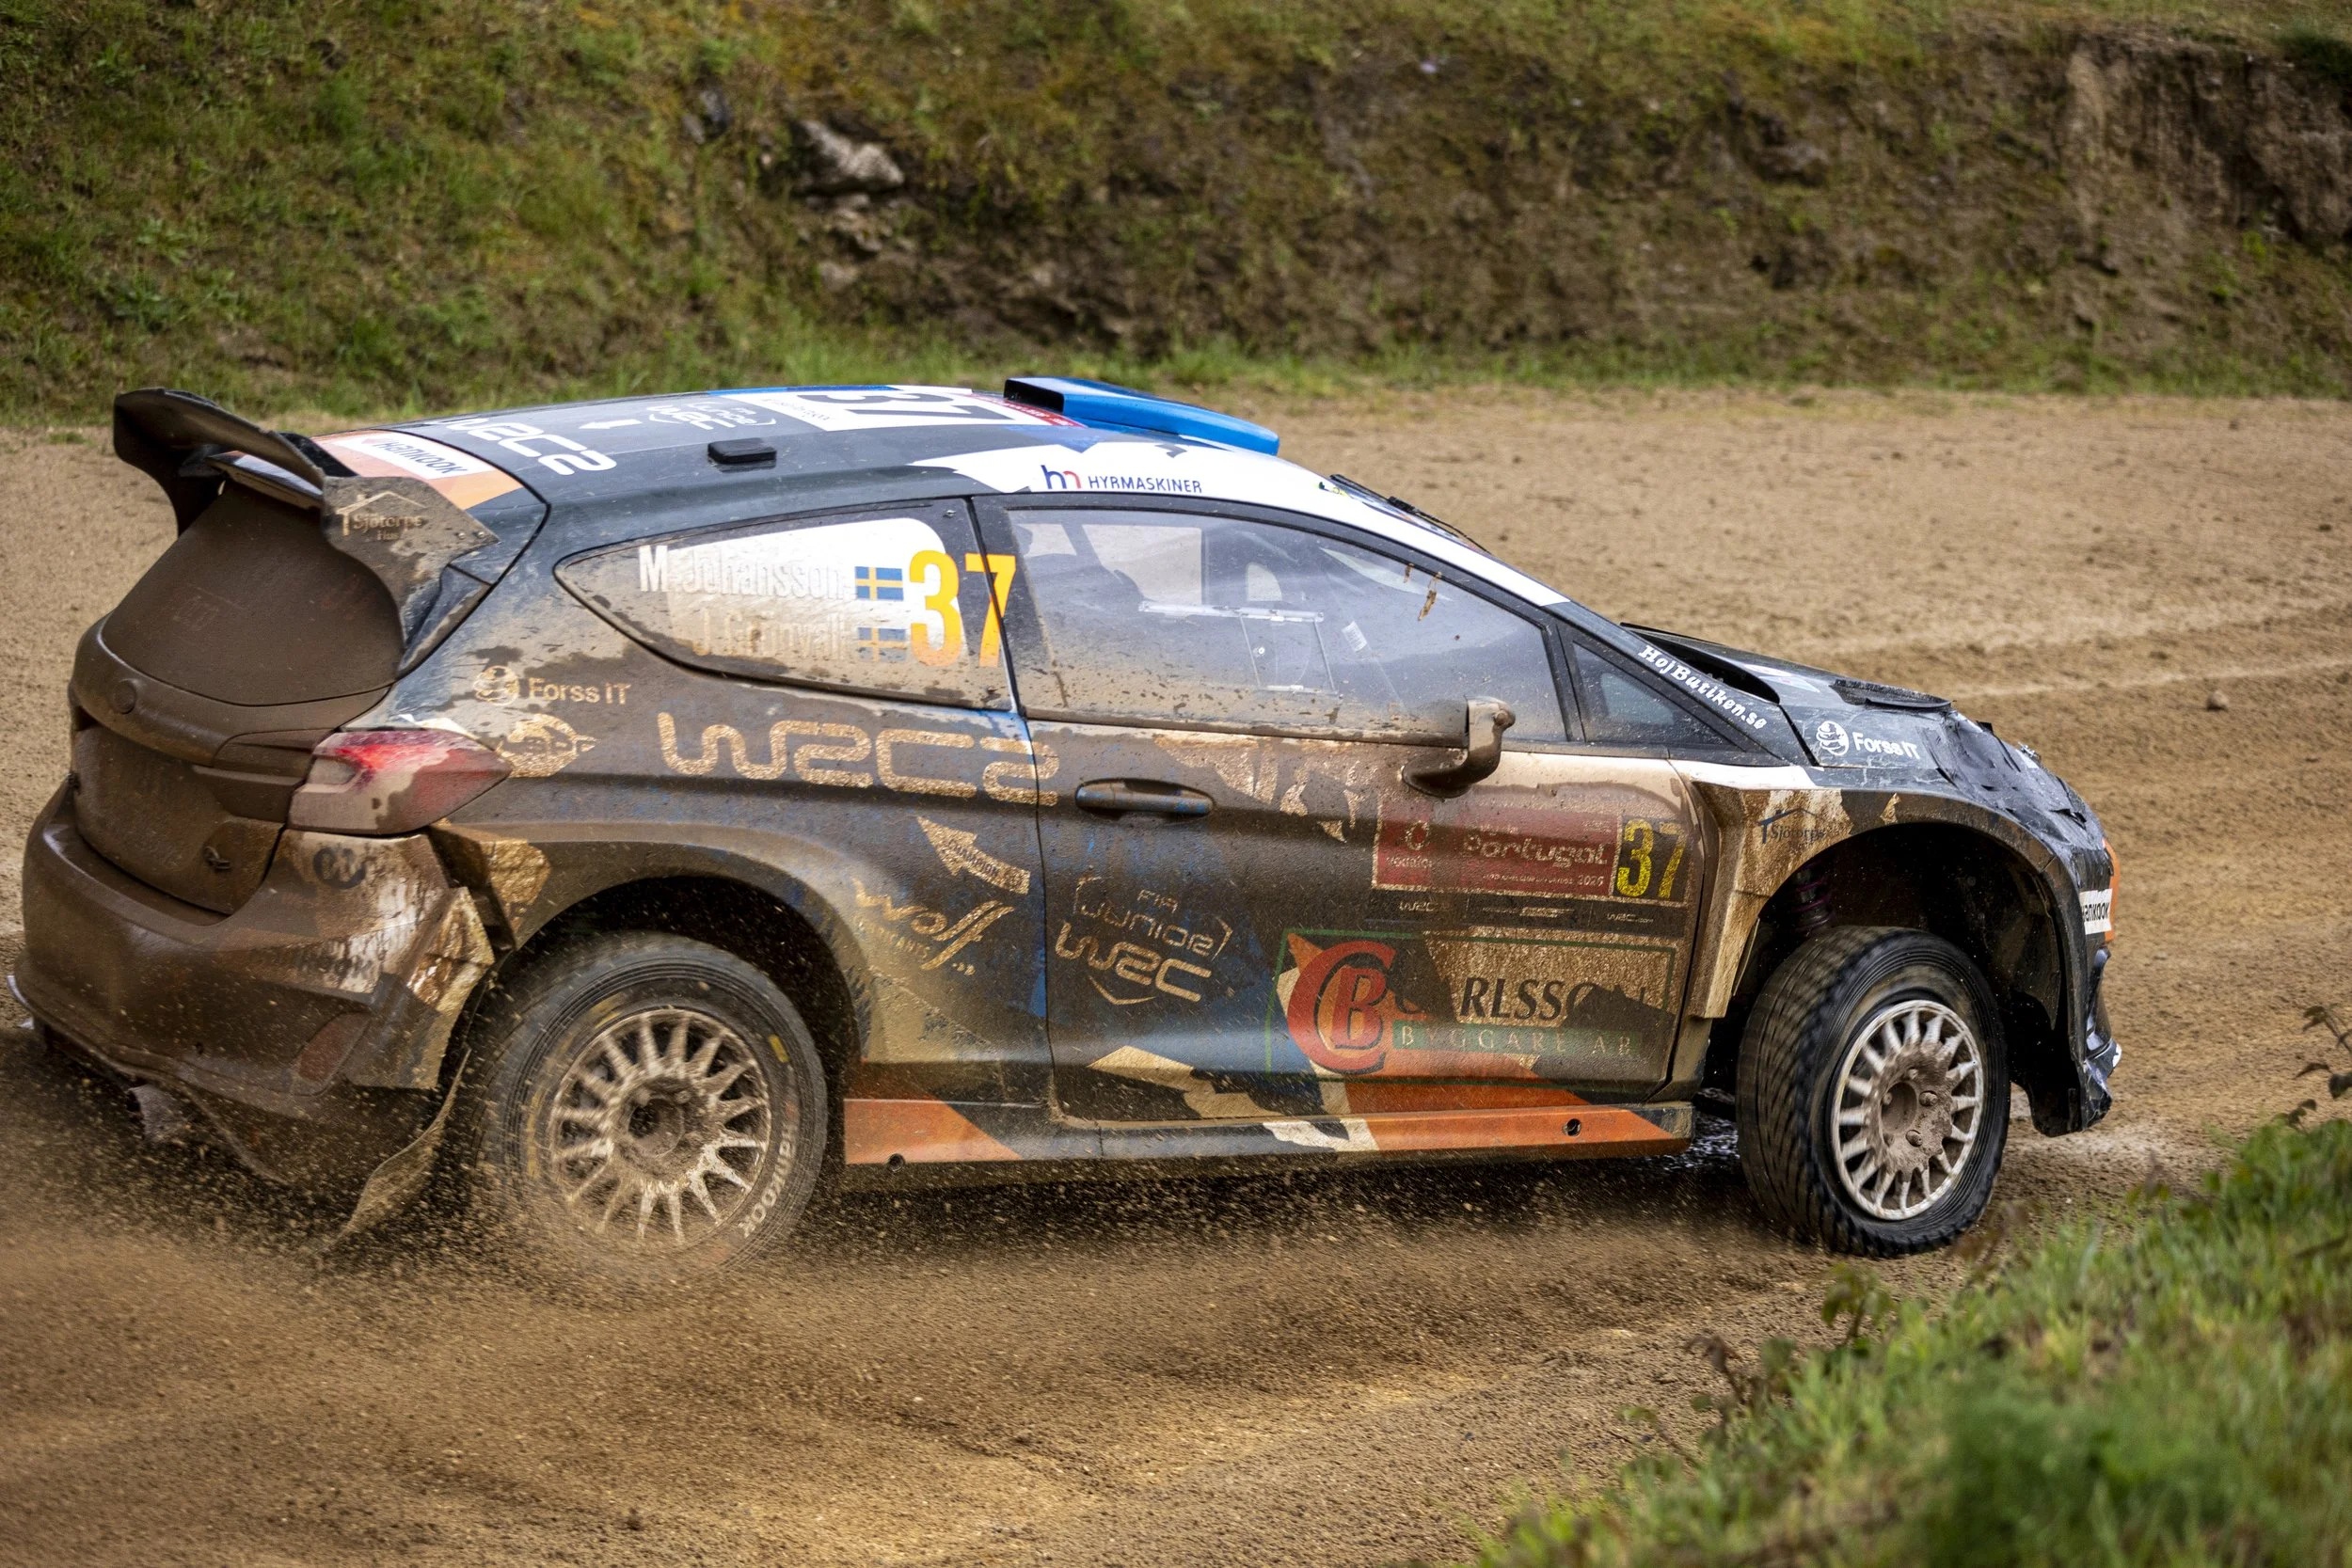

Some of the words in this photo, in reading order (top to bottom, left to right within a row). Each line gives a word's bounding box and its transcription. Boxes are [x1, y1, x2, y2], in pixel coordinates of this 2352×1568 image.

[1088, 475, 1202, 494] HYRMASKINER
[683, 546, 851, 602] Johansson
[908, 549, 1017, 668] 37
[529, 676, 600, 704] Forss
[605, 682, 632, 705] IT
[1638, 645, 1768, 730] HojButiken.se
[657, 712, 1058, 807] WRC2
[1851, 731, 1900, 757] Forss
[1900, 740, 1921, 760] IT
[1464, 832, 1610, 869] Portugal
[1616, 819, 1687, 898] 37
[1080, 901, 1215, 958] JUNIOR
[1136, 889, 1179, 914] FIA
[1055, 922, 1213, 1003] WRC
